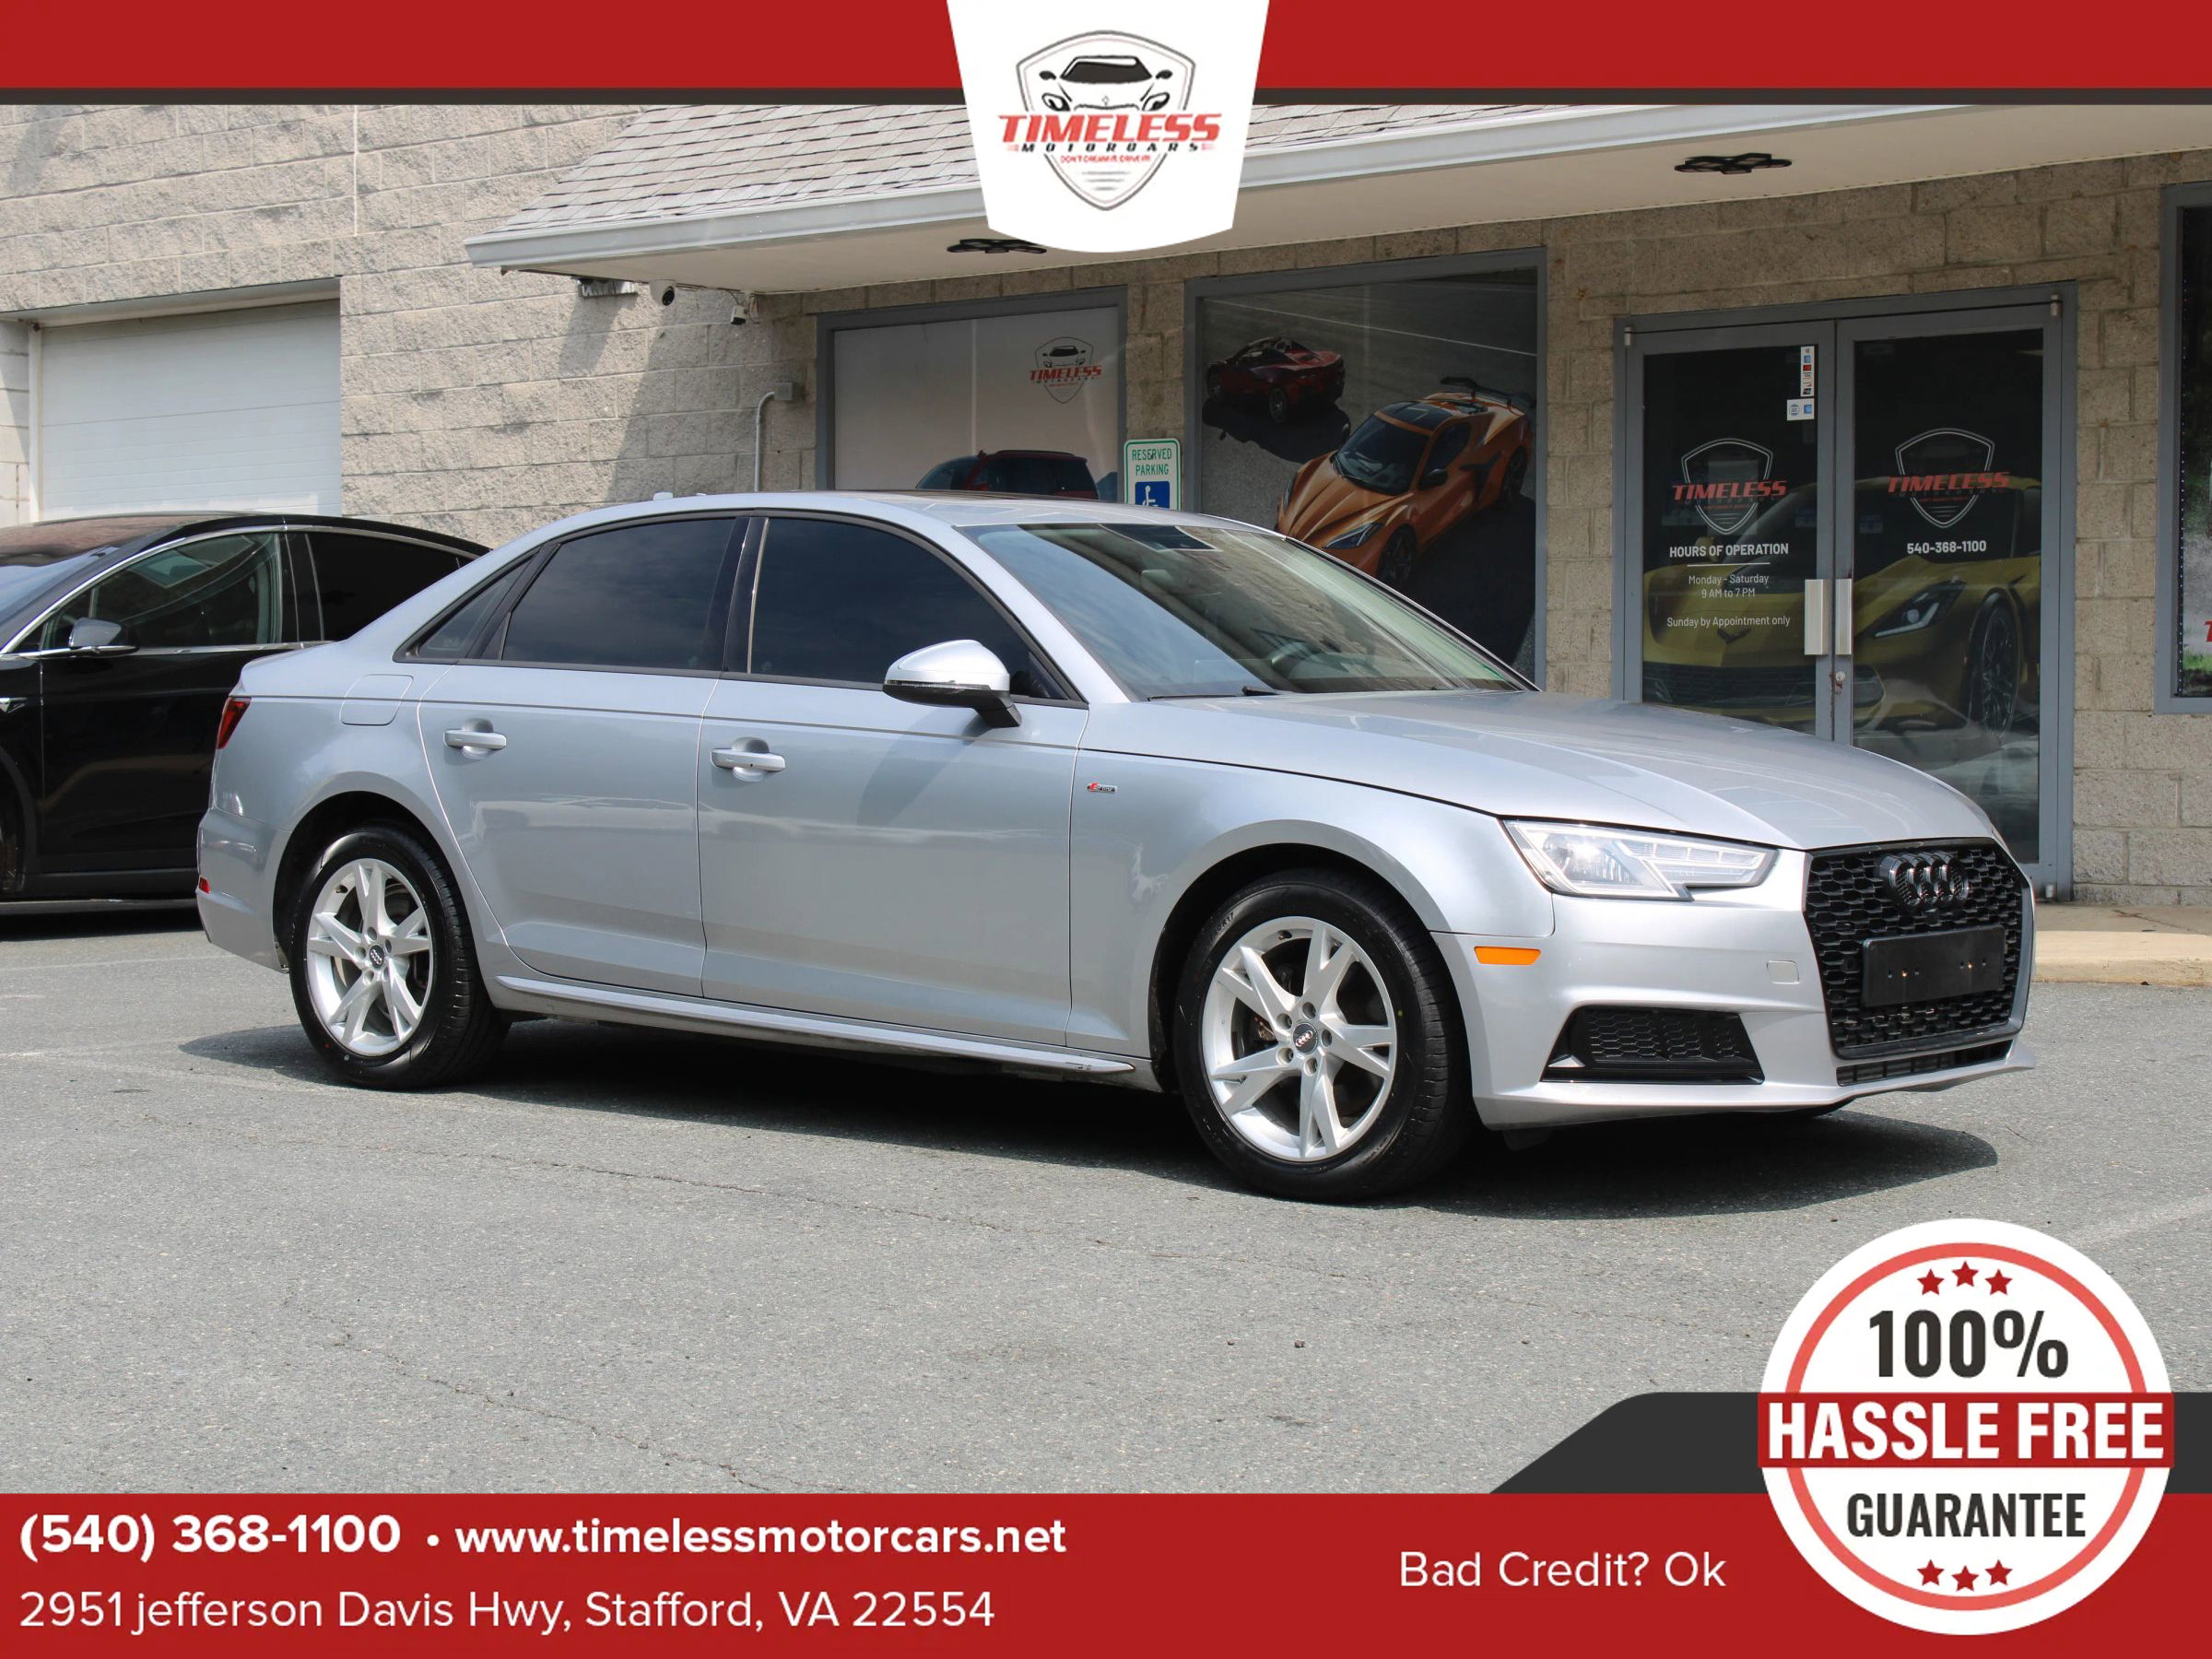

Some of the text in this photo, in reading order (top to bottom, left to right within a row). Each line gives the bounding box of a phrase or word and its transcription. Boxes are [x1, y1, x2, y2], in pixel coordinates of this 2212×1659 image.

[1030, 365, 1102, 382] TIMELESS
[1132, 448, 1172, 460] RESERVED
[1135, 464, 1170, 476] PARKING
[1888, 472, 2010, 492] TIMELESS
[1672, 480, 1787, 500] TIMELESS
[1669, 543, 1789, 558] HOURS OF OPERATION
[1907, 540, 1987, 554] 540-368-1100
[1688, 574, 1722, 587] Monday
[1729, 573, 1770, 587] Saturday
[1701, 588, 1756, 598] 9 AM to 7 PM
[1666, 615, 1791, 629] Sunday by Appointment only
